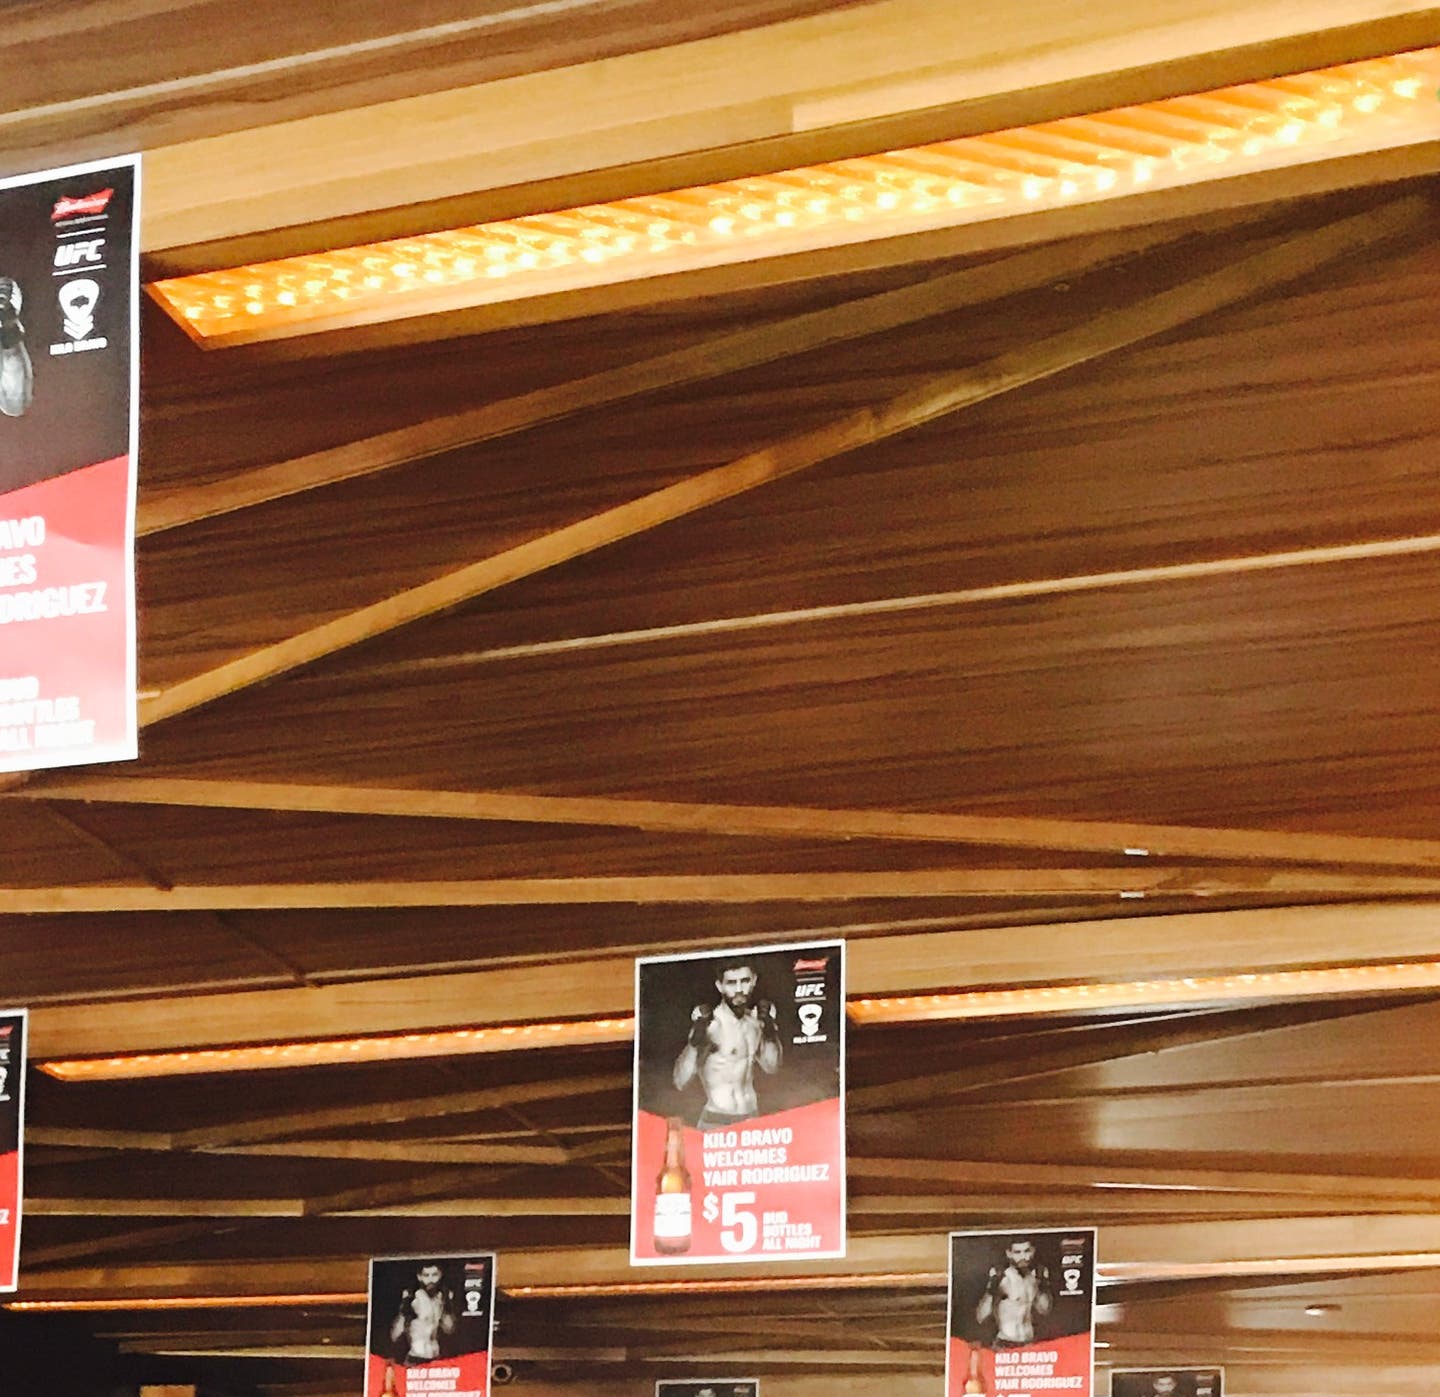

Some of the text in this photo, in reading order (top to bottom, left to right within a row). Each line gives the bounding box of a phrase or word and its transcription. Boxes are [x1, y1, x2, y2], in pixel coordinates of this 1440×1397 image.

[54, 239, 105, 267] UFC
[795, 983, 826, 998] UFC
[703, 1127, 793, 1149] KILO BRAVO
[703, 1147, 787, 1168] WELCOMES
[703, 1163, 830, 1187] YAIR RODRIGUEZ
[702, 1191, 758, 1252] $5
[762, 1211, 788, 1225] BUD
[762, 1222, 813, 1237] BOTTLES
[762, 1235, 822, 1250] ALL NIGHT
[994, 1364, 1054, 1377] WELCOMES
[994, 1376, 1084, 1391] YAIR RODRIGUEZ
